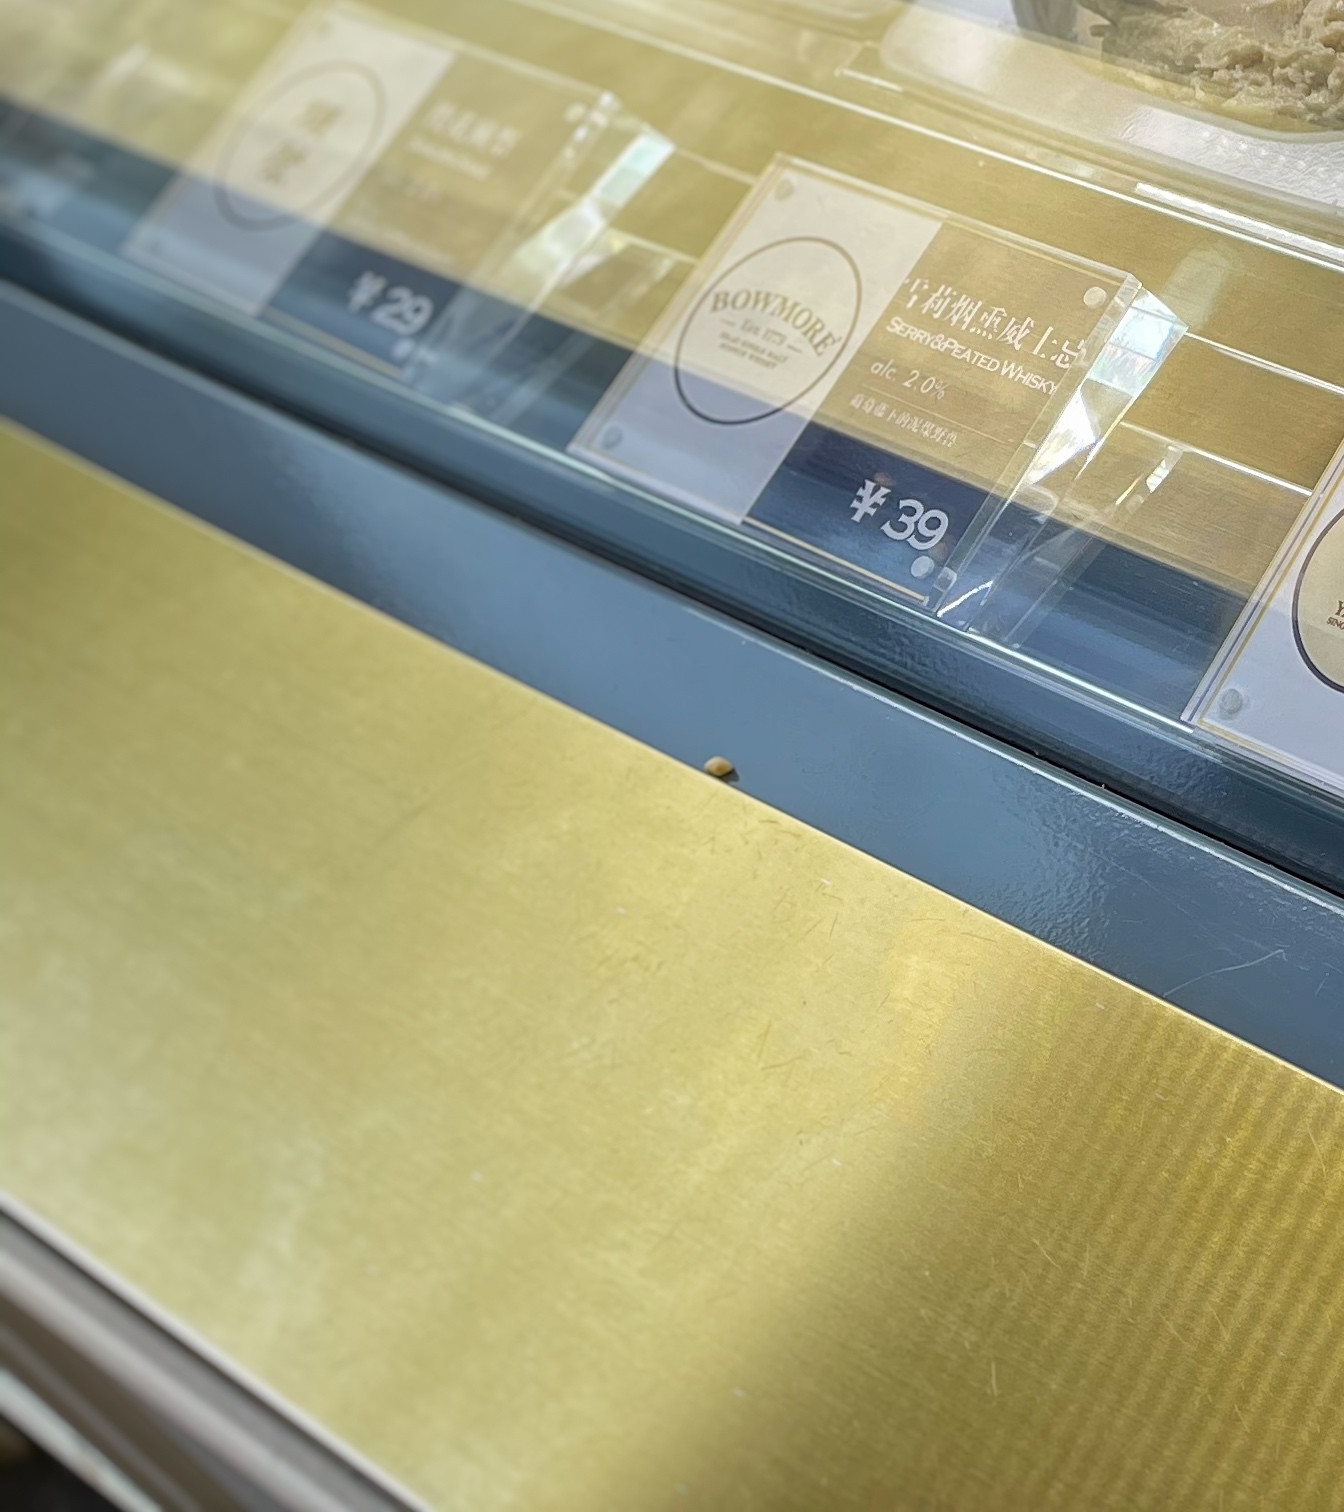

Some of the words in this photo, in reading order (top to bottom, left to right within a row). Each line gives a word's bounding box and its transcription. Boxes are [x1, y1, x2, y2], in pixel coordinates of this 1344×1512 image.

[710, 288, 837, 356] BOWMORE
[1000, 359, 1059, 395] WHISKY
[880, 498, 949, 550] 39
